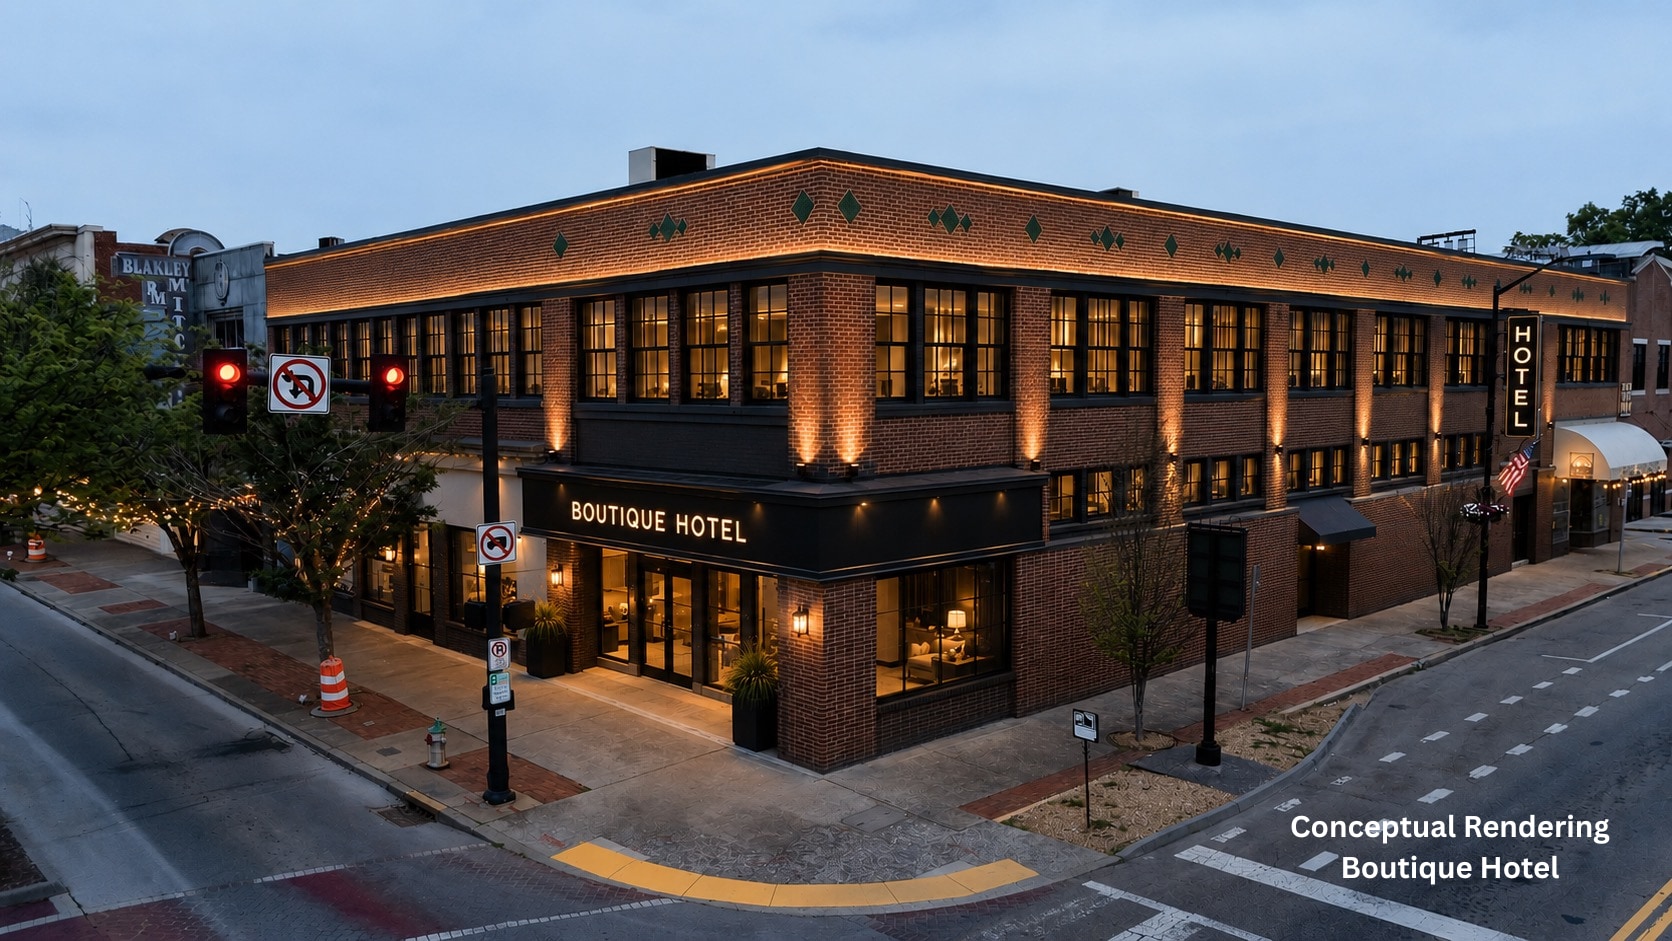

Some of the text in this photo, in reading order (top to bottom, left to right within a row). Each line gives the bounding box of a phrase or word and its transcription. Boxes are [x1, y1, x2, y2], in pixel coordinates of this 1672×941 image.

[122, 258, 190, 277] BLAKLEY
[1513, 326, 1532, 427] HOTEL
[571, 501, 747, 543] BOUTIQUE HOTEL
